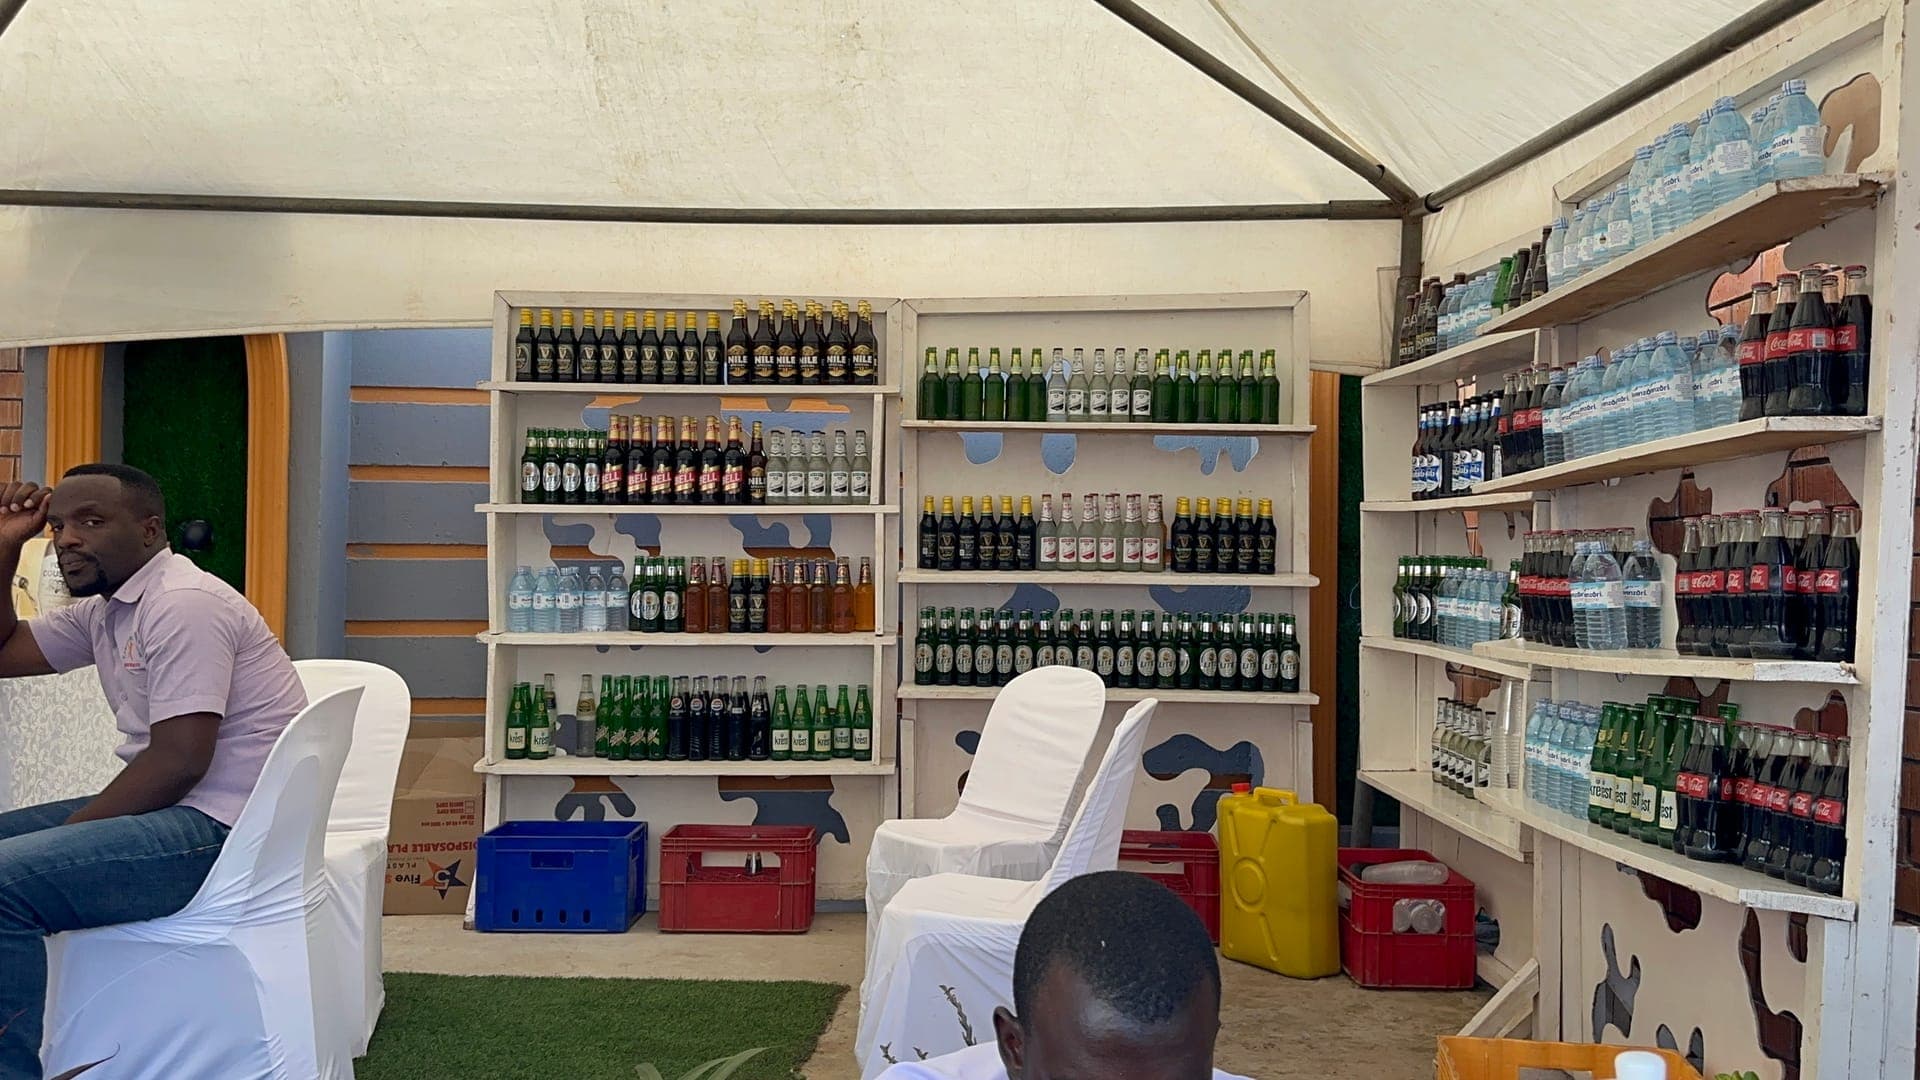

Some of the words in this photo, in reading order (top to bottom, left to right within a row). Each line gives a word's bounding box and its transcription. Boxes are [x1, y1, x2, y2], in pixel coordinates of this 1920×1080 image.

[728, 356, 748, 364] NILE
[754, 355, 774, 364] NILE
[776, 356, 796, 364] NILE
[827, 355, 846, 364] NILE
[852, 355, 872, 364] NILE
[629, 472, 647, 485] BELL
[510, 734, 523, 743] krest
[775, 736, 788, 745] krest
[794, 737, 807, 746] krest
[835, 736, 848, 744] krest
[855, 736, 867, 744] krest
[387, 843, 408, 853] PLA
[385, 874, 393, 884] S
[395, 874, 421, 885] Five
[434, 870, 450, 890] 5
